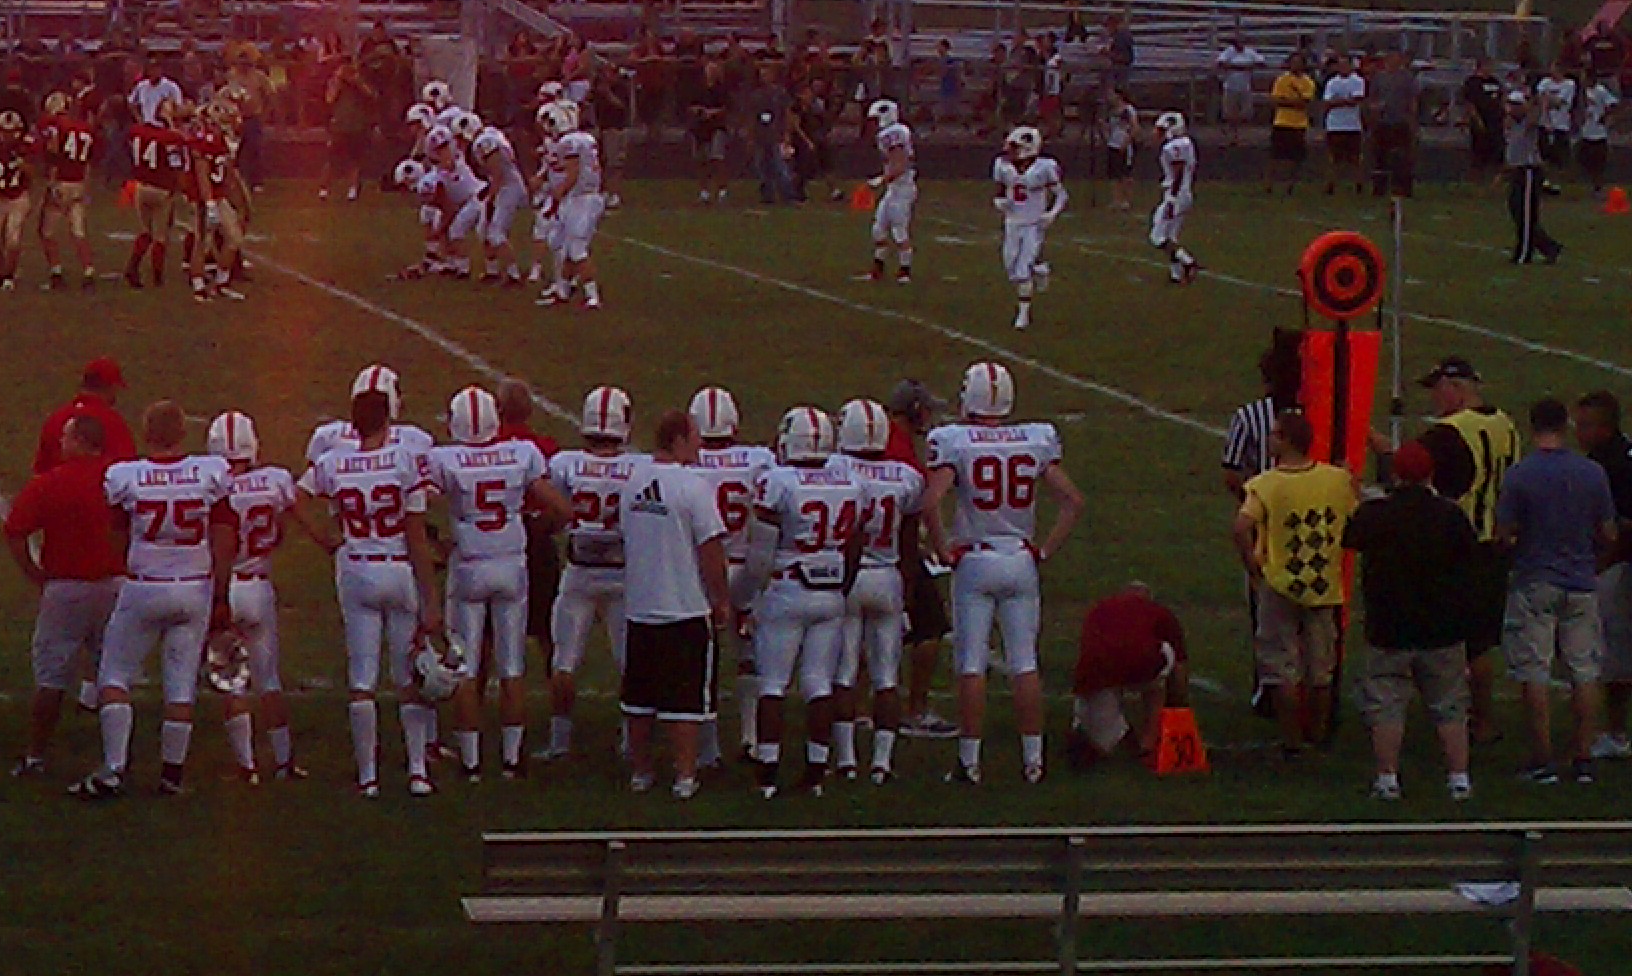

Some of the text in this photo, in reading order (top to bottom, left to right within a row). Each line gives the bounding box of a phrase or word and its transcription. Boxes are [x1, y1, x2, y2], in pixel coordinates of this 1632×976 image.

[63, 128, 93, 163] 47
[132, 135, 158, 171] 14
[476, 480, 507, 532] 5
[972, 454, 1036, 510] 96
[136, 500, 204, 545] 75
[795, 500, 856, 554] 34
